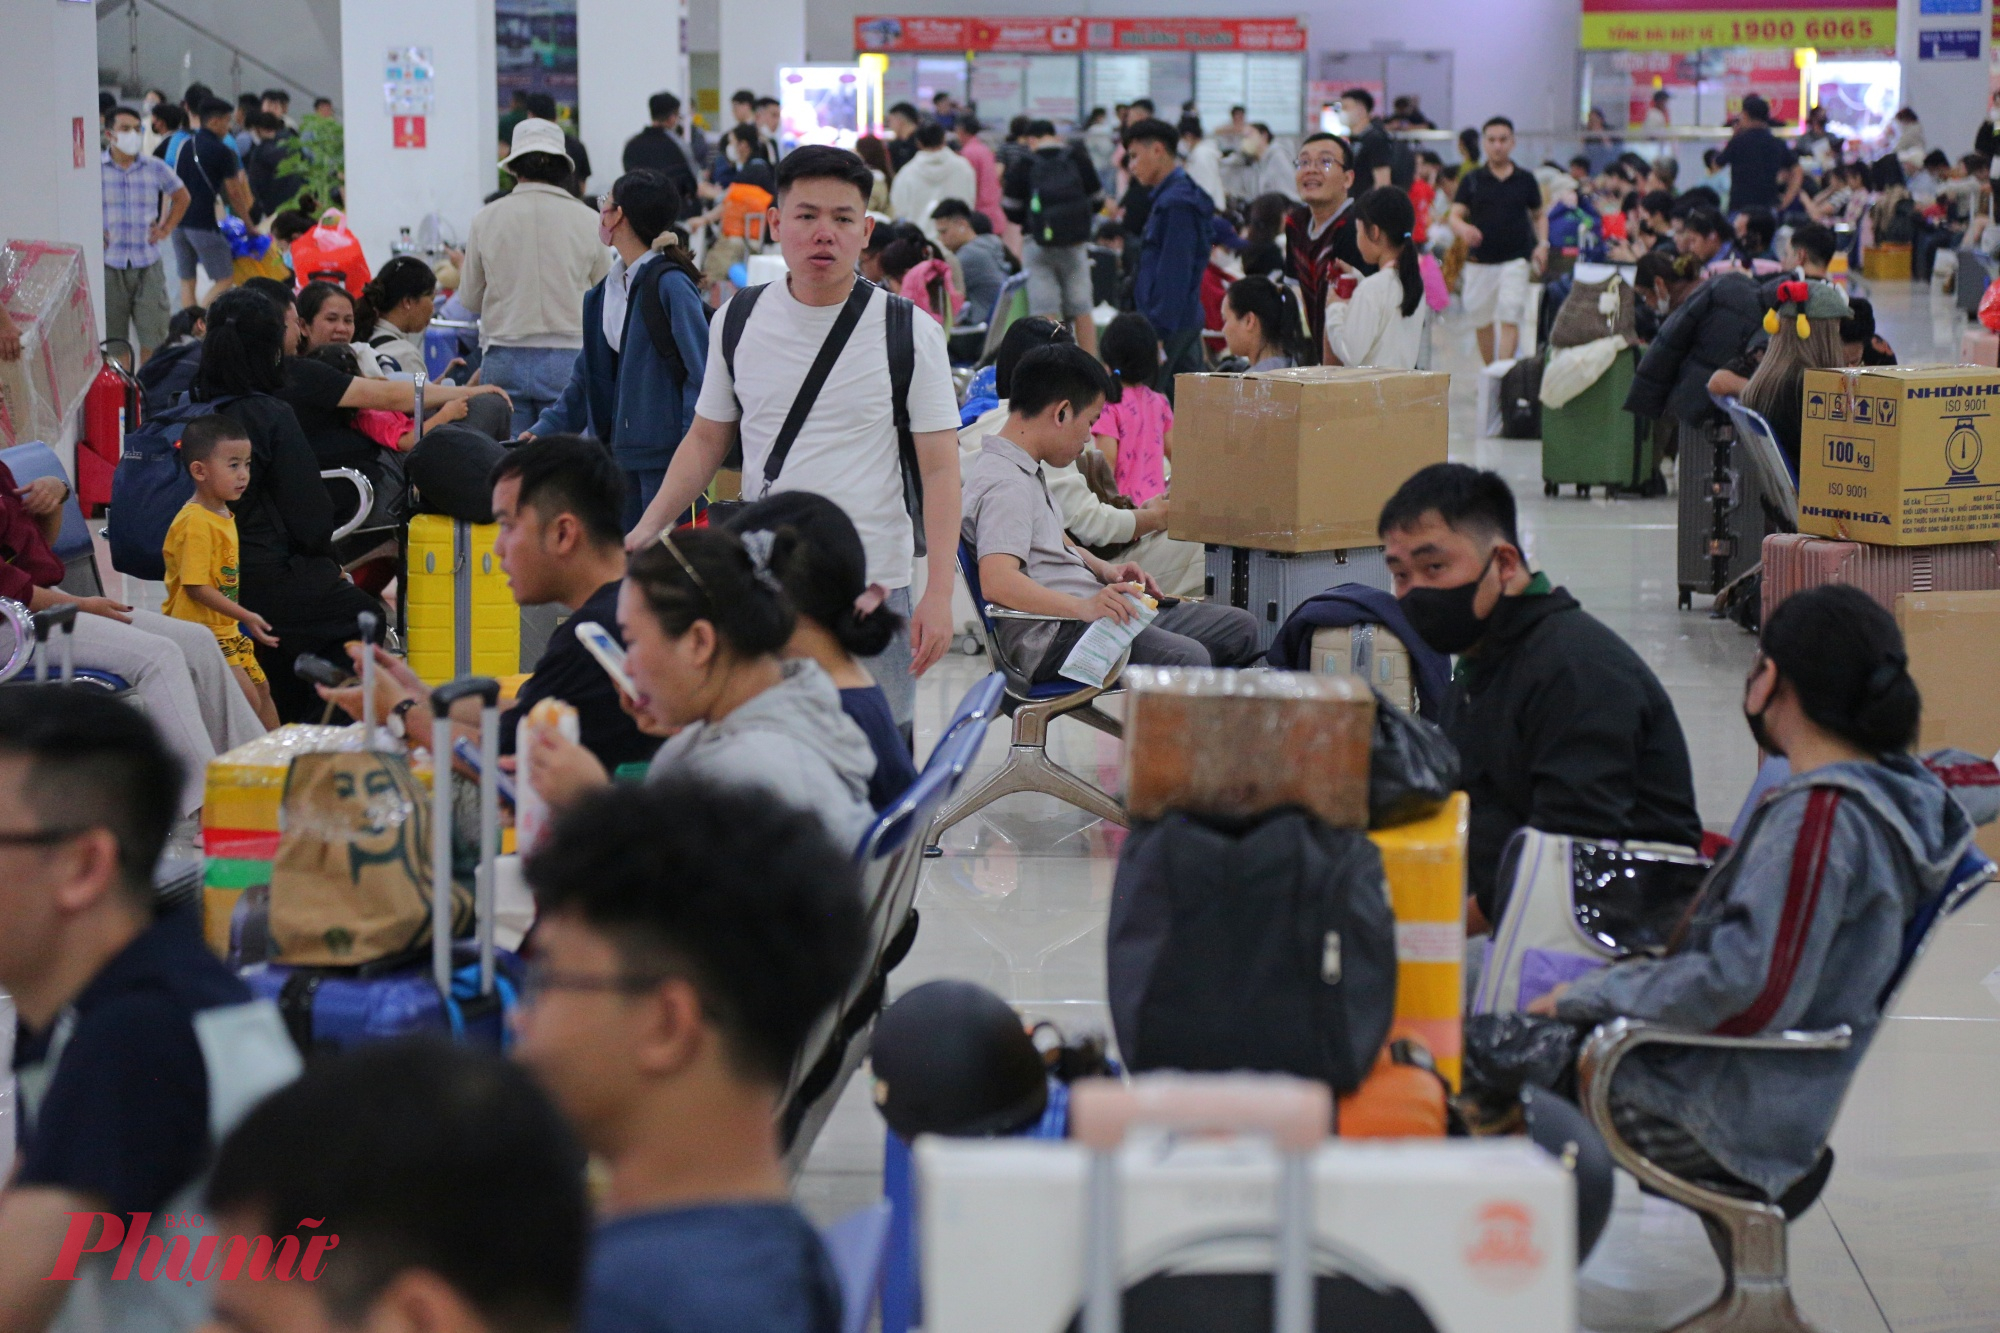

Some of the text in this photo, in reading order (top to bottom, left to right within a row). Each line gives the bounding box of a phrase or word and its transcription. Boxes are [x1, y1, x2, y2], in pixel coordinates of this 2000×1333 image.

[1731, 20, 1795, 40] 1900
[1805, 20, 1873, 39] 6065
[1945, 399, 1987, 412] ISO 9001
[1828, 441, 1870, 468] 100 kg
[1828, 482, 1867, 498] ISO 9001
